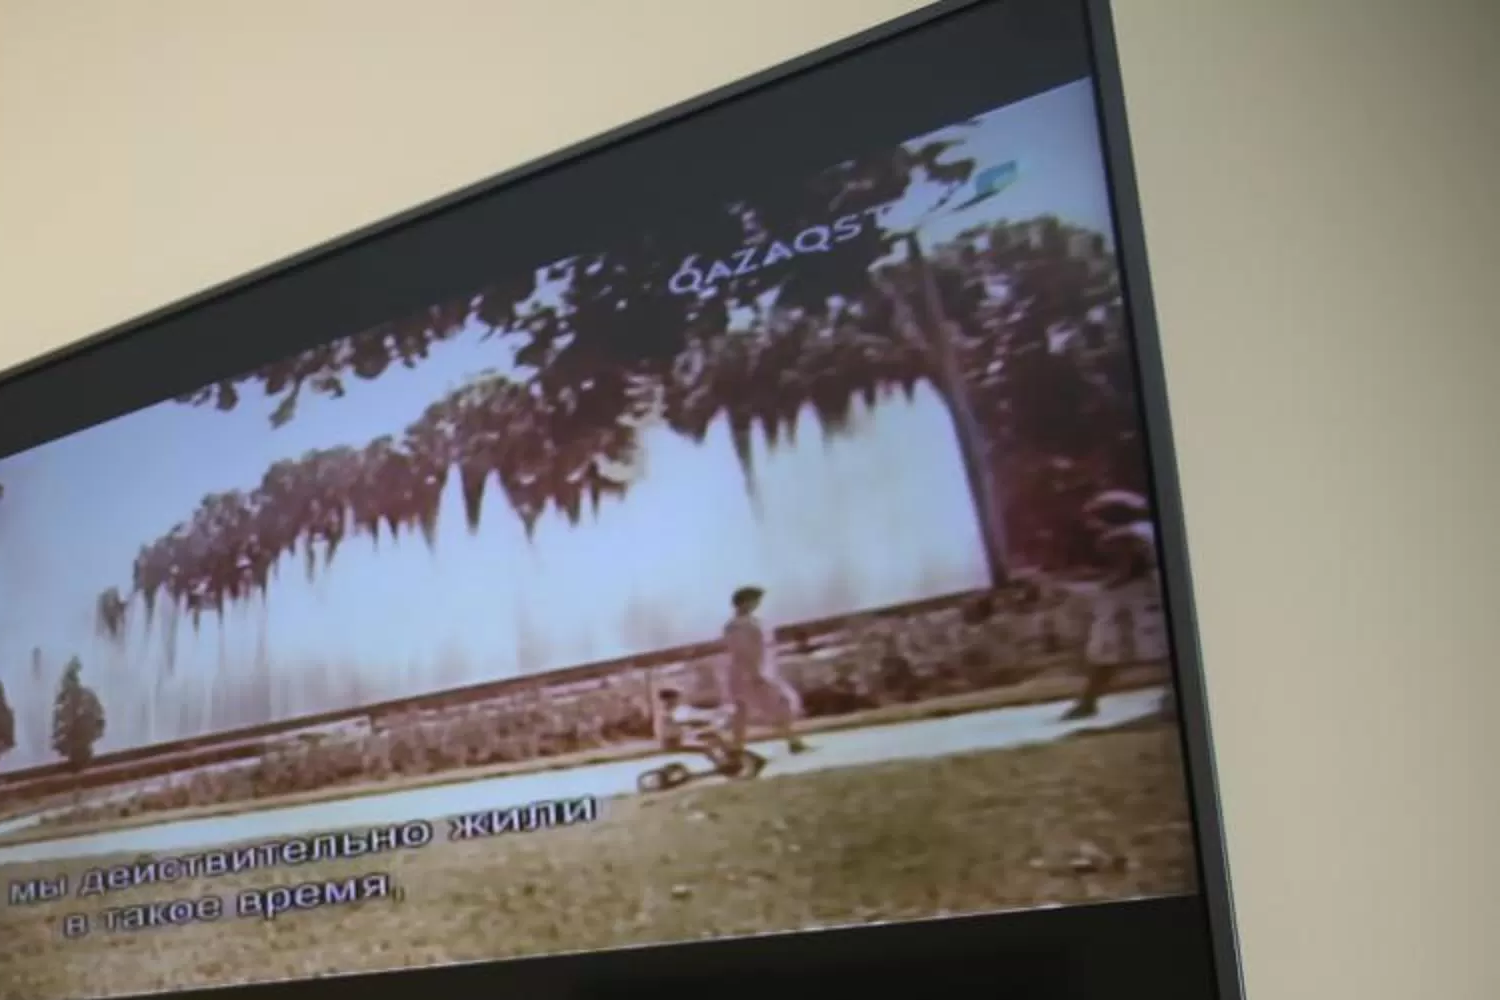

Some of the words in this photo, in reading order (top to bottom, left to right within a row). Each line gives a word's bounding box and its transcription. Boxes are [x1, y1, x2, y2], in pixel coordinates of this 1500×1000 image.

[10, 876, 67, 904] мы
[79, 820, 432, 896] действительно
[448, 796, 597, 841] жили
[65, 915, 89, 937] в
[104, 898, 224, 933] такое
